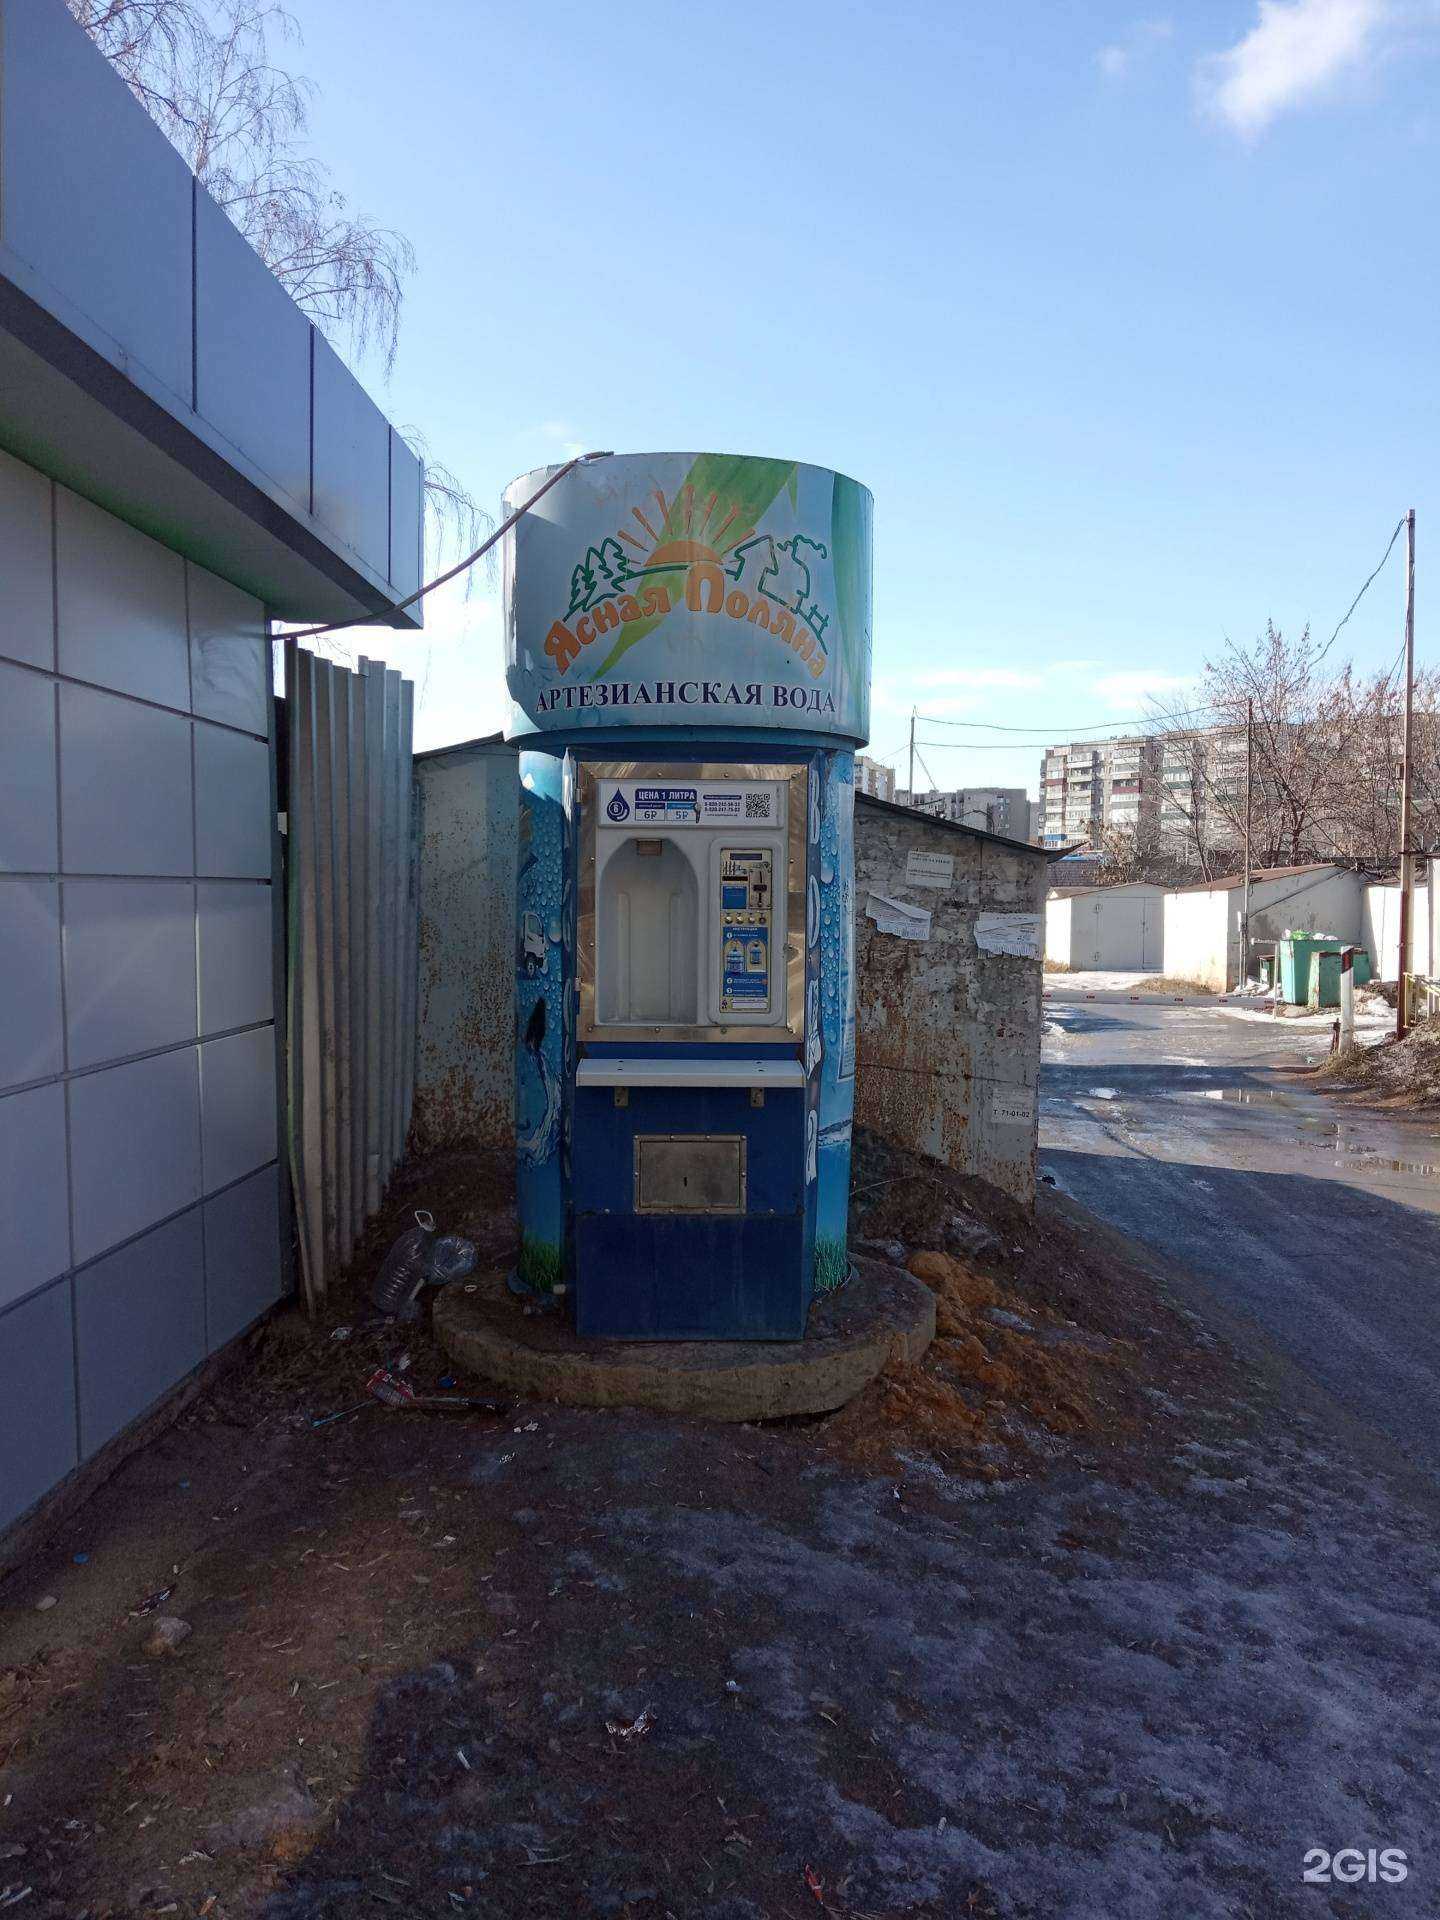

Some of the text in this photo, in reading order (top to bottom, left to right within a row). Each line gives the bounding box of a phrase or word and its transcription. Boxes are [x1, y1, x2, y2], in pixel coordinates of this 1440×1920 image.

[544, 561, 827, 680] Ясная Поляна
[535, 681, 836, 714] АРТЕЗИАНСКАЯ ВОДА
[638, 791, 659, 800] ЦЕНА
[661, 792, 666, 800] 1
[668, 791, 695, 800] ЛИТРА
